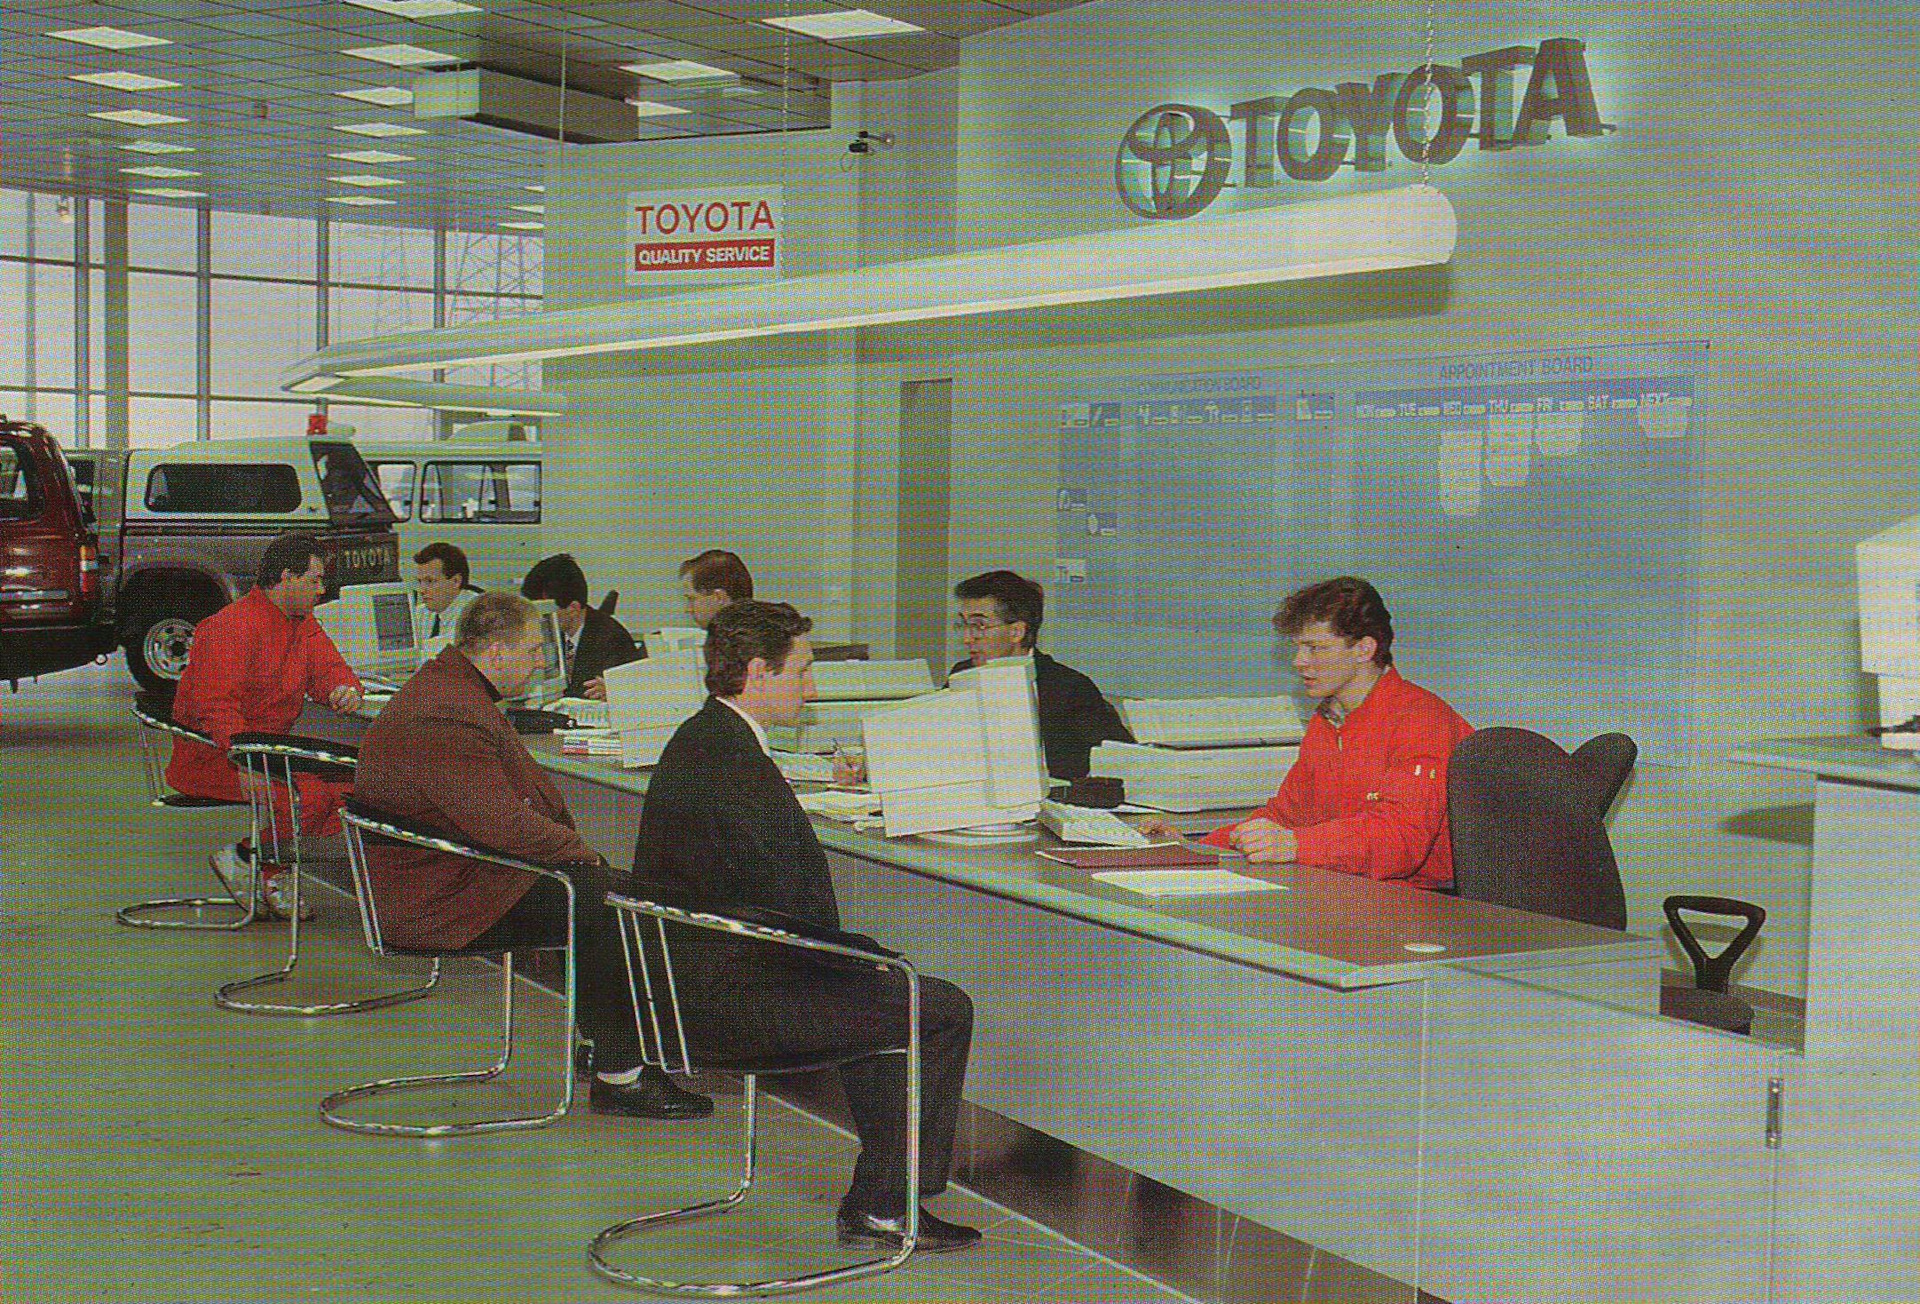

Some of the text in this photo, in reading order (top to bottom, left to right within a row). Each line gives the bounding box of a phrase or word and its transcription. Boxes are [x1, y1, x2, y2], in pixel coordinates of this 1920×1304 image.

[1231, 38, 1602, 188] TOYOTA
[635, 200, 775, 234] TOYOTA
[639, 246, 770, 265] QUALITY SERVICE
[1440, 355, 1593, 381] APPOINTMENT BOARD
[1221, 375, 1262, 392] BOARD
[1398, 402, 1417, 417] TUE
[1488, 398, 1509, 413] THU
[1587, 394, 1610, 411] SAT
[343, 547, 392, 569] TOYOTA
